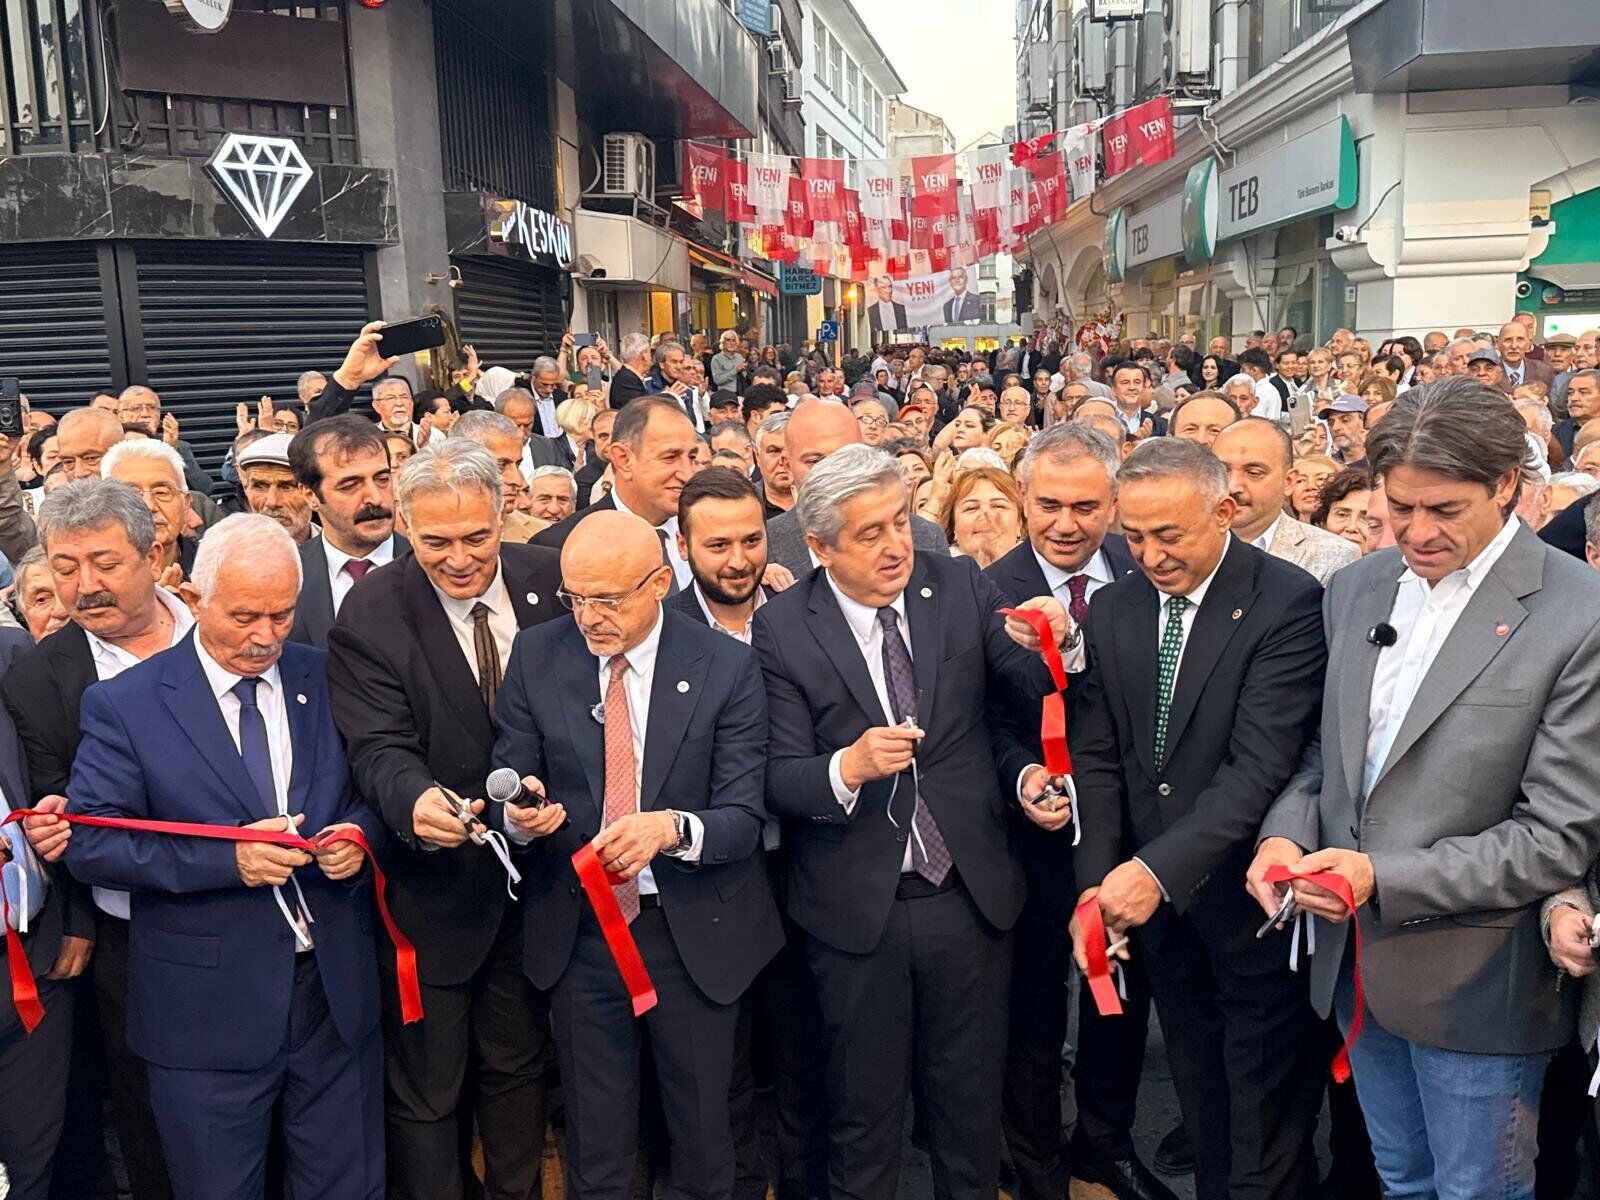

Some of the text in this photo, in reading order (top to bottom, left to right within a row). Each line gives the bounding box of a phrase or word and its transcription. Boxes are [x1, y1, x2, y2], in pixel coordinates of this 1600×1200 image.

[1108, 133, 1128, 153] YEN
[1075, 154, 1092, 171] YEN
[730, 182, 748, 196] YEN
[1228, 175, 1259, 222] TEB
[1132, 224, 1149, 256] TEB
[822, 323, 831, 337] P
